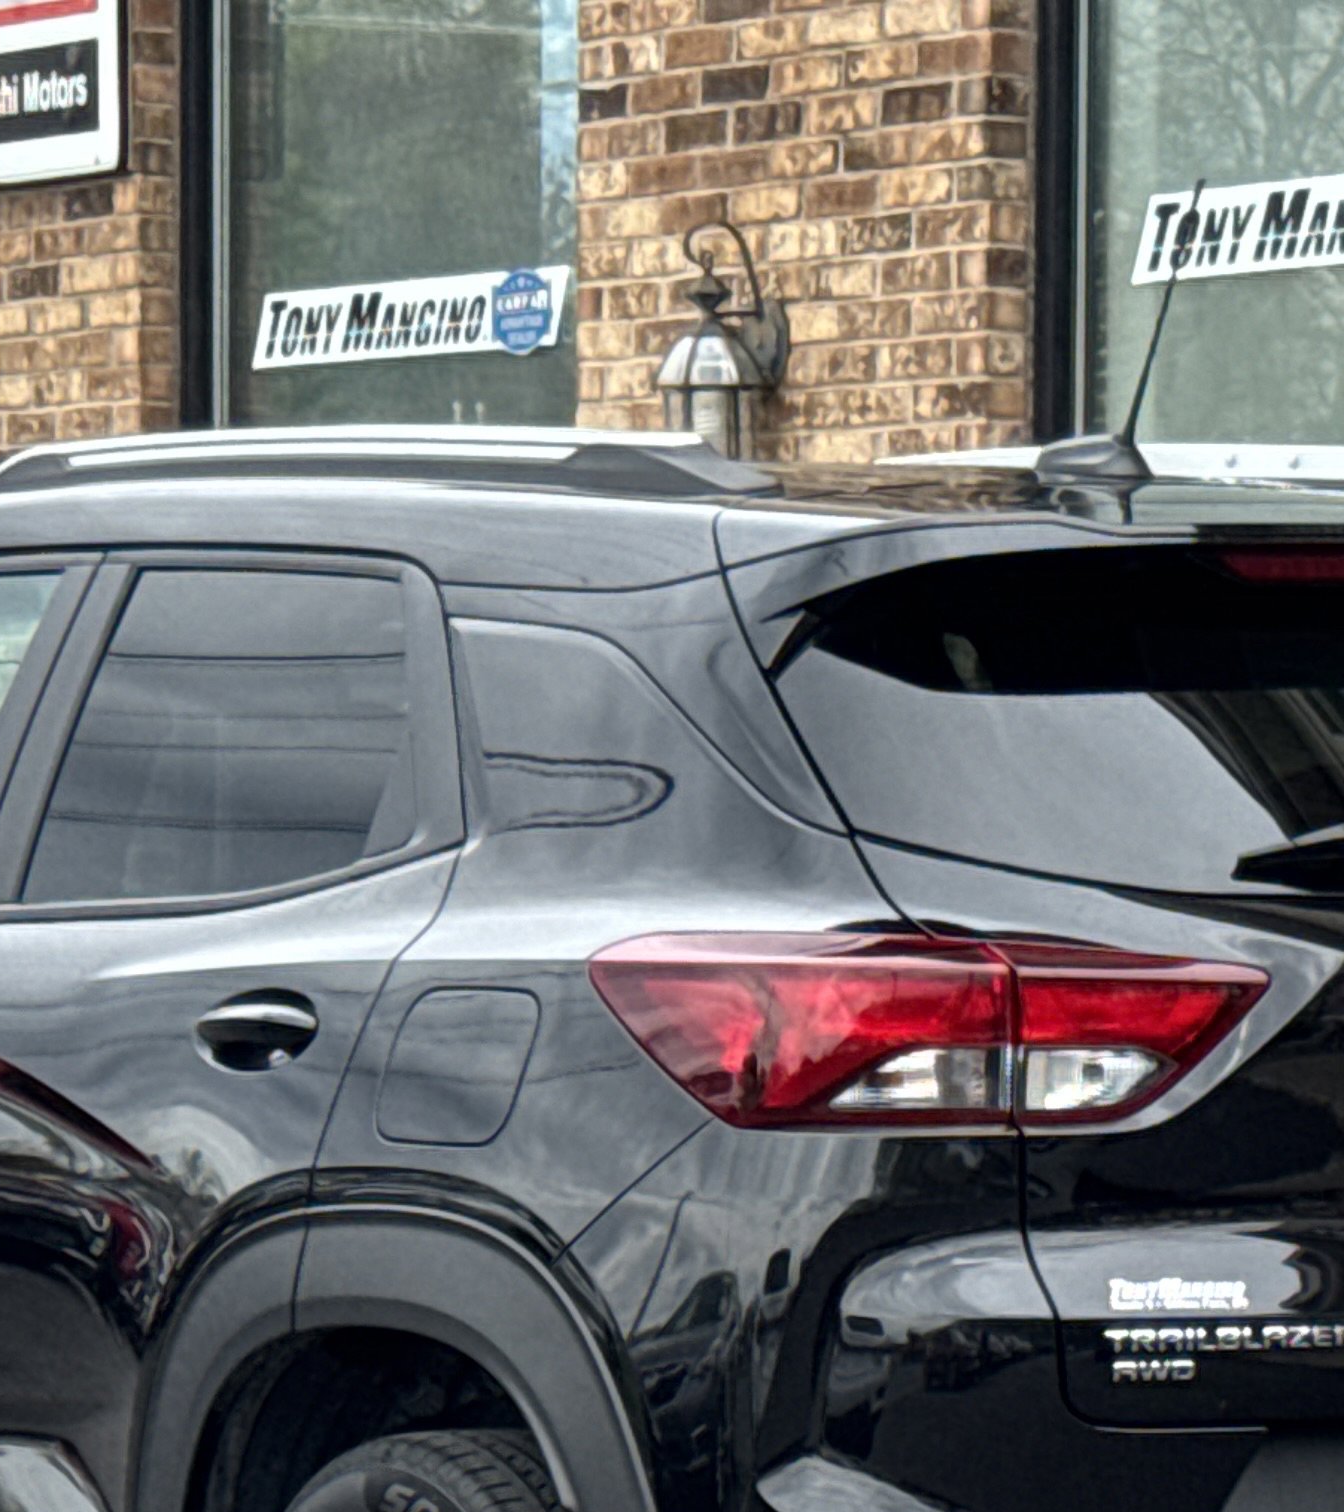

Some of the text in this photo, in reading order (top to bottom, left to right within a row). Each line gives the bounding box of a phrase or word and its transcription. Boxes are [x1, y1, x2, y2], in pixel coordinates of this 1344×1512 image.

[23, 69, 88, 113] Motors
[1147, 202, 1256, 273] TONY
[265, 291, 487, 359] TONY MANGINO
[1112, 1360, 1196, 1383] AWD
